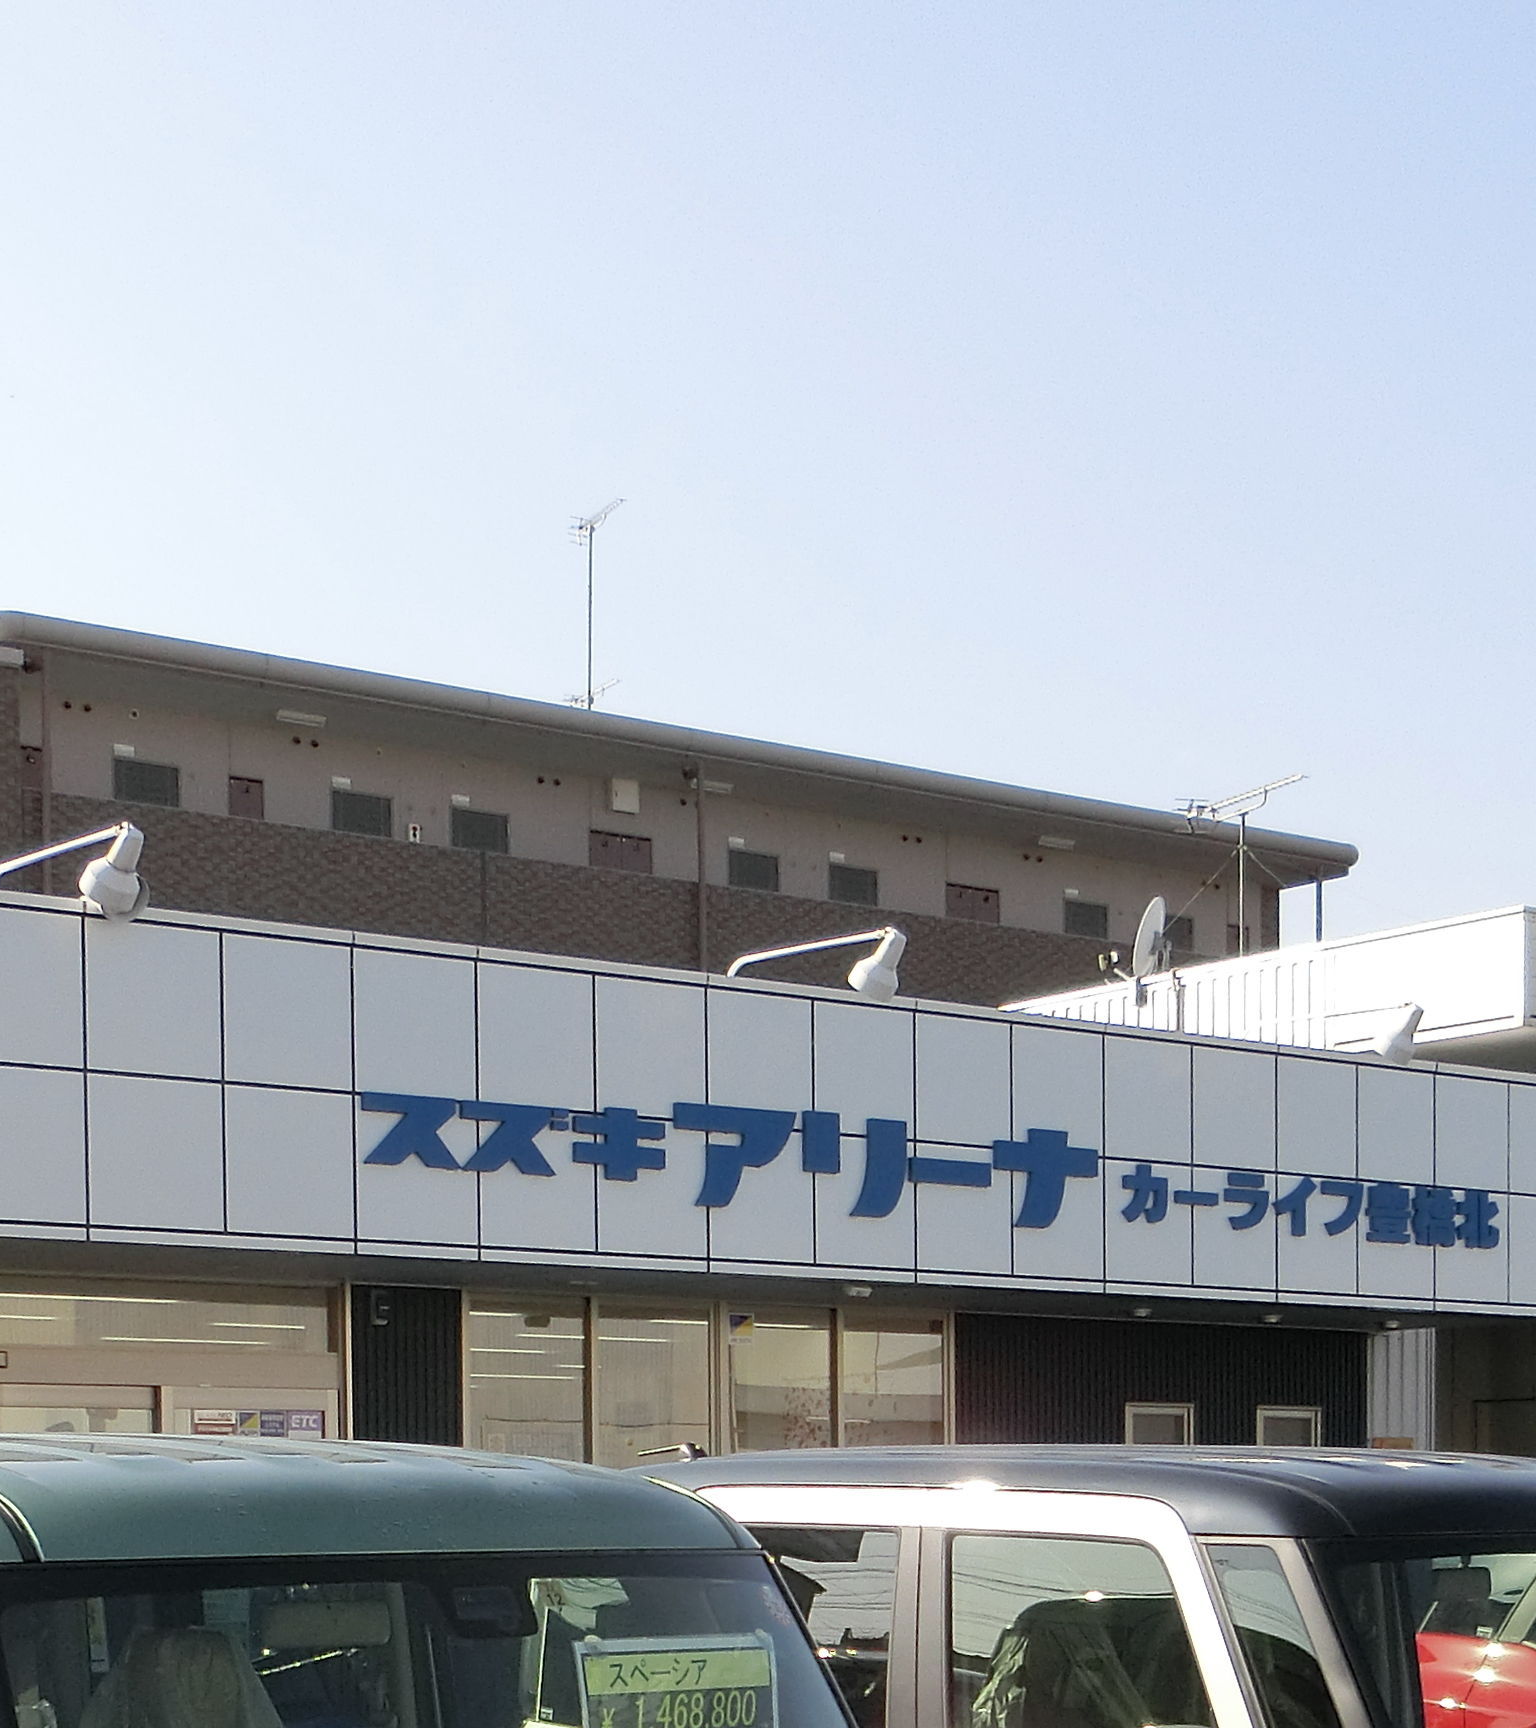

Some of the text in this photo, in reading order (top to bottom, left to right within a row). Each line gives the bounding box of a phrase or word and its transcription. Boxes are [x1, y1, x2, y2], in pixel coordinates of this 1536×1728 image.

[360, 1091, 1099, 1228] スズキアリーナ
[291, 1414, 318, 1428] ETC
[609, 1658, 708, 1688] スペーシア
